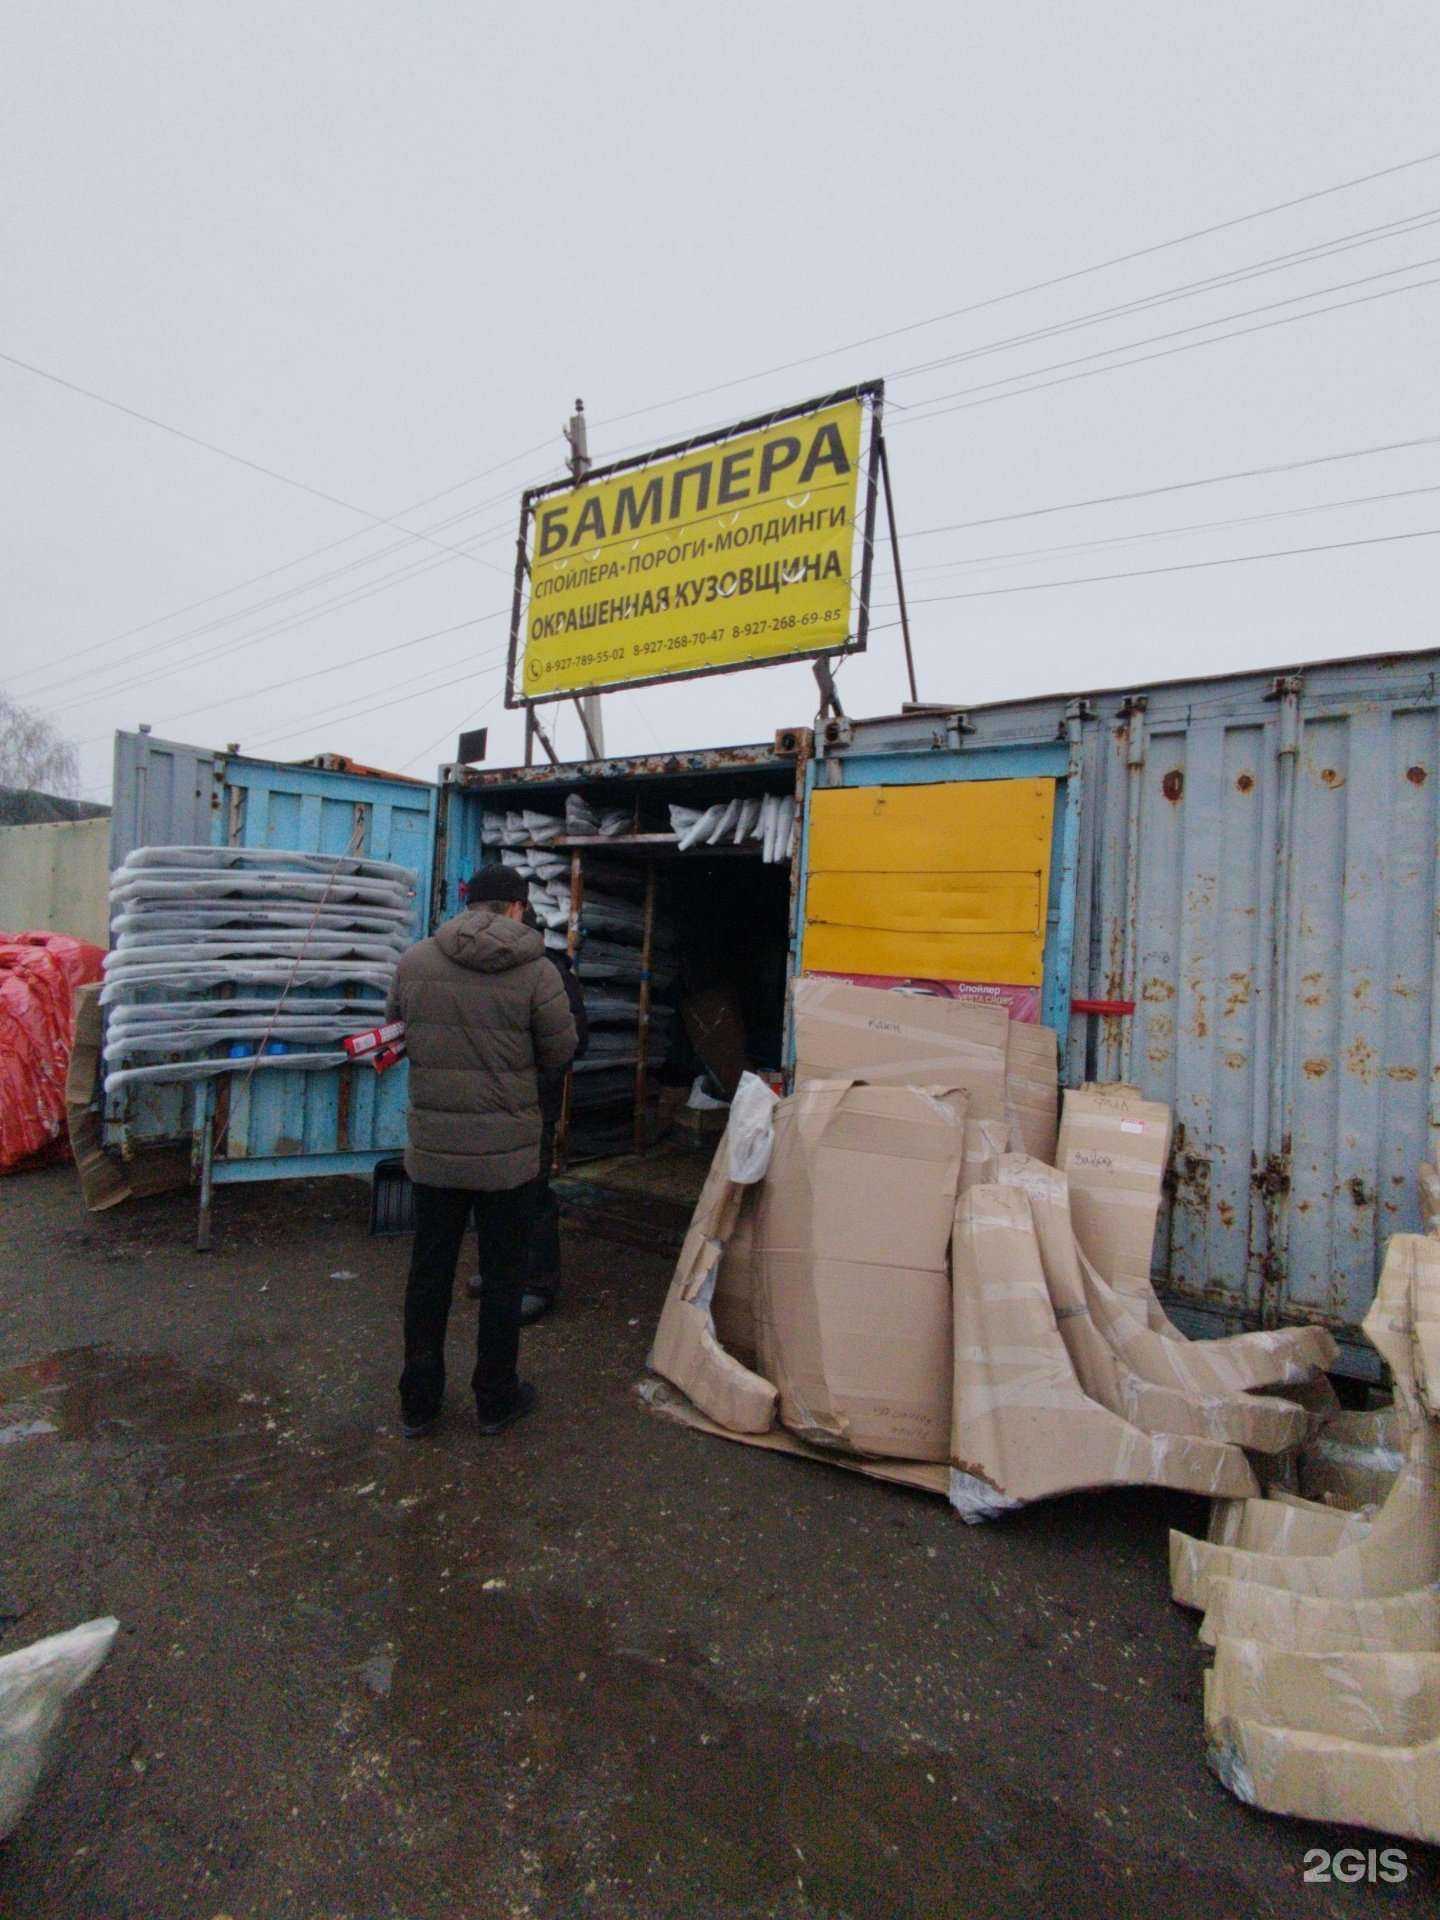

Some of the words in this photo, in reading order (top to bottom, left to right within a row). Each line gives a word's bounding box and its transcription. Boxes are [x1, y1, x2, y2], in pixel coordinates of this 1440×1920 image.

[539, 422, 850, 557] БАМПЕРА
[532, 586, 669, 640] ОКРАШЕННАЯ
[675, 550, 842, 608] КУЗОВЩИНА
[545, 648, 625, 673] 8-927-789-55-02
[633, 628, 725, 656] 8-927-268-70-47
[732, 609, 841, 639] 8-927-268-69-85
[959, 983, 1000, 996] Спойлер
